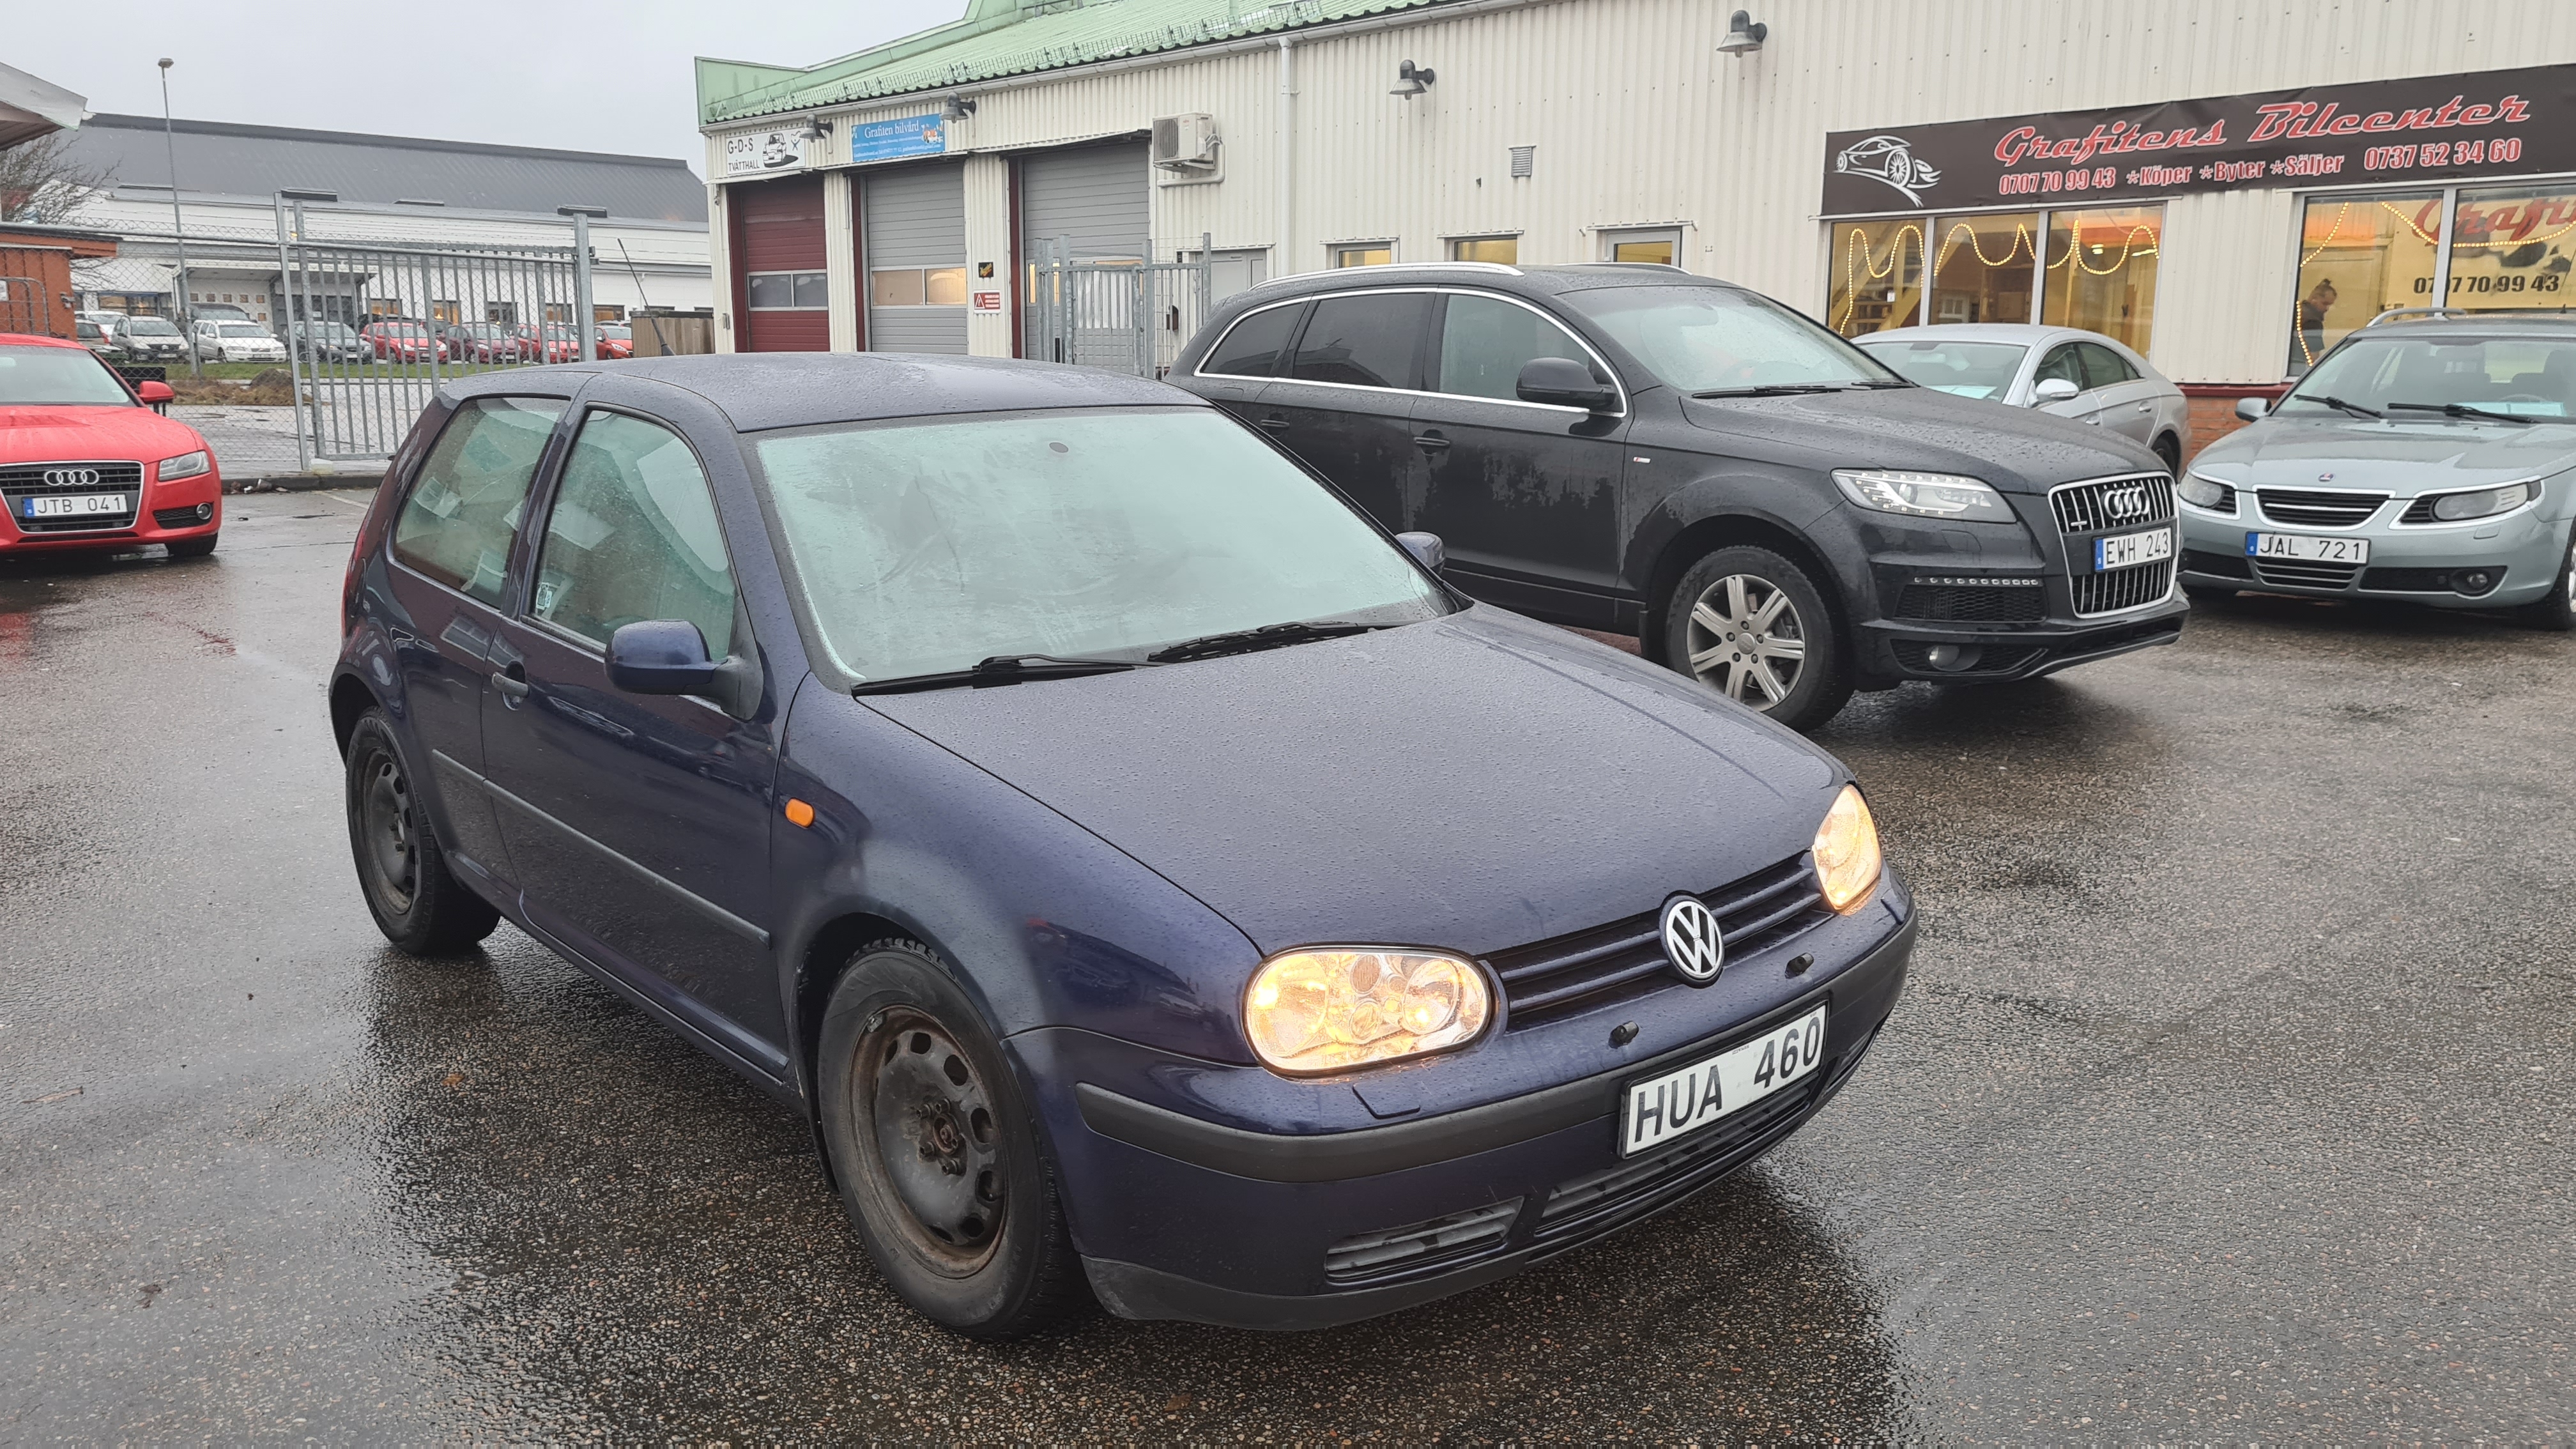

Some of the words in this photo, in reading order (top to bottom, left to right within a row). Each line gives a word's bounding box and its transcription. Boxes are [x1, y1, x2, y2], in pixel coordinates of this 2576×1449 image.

[864, 125, 893, 139] Grafiten
[895, 119, 919, 134] bilvård
[1994, 119, 2228, 167] Grafitens
[2246, 95, 2531, 142] Bilcenter
[1999, 174, 2040, 195] 0707
[2041, 171, 2063, 192] 70
[2066, 169, 2090, 190] 99
[2091, 167, 2117, 188] 43
[2363, 144, 2417, 171] 0737
[2419, 142, 2451, 168] 52
[2453, 139, 2485, 165] 34
[2488, 137, 2522, 163] 60
[2467, 275, 2490, 293] 70
[2497, 275, 2526, 292] 99
[2531, 274, 2559, 292] 43
[36, 498, 73, 514] JTB
[87, 496, 121, 512] 041
[2106, 537, 2136, 565] EWH
[2146, 532, 2168, 558] 243
[2260, 537, 2299, 557] JAL
[2319, 540, 2360, 560] 721
[1634, 1064, 1723, 1143] HUA
[1754, 1016, 1821, 1089] 460
